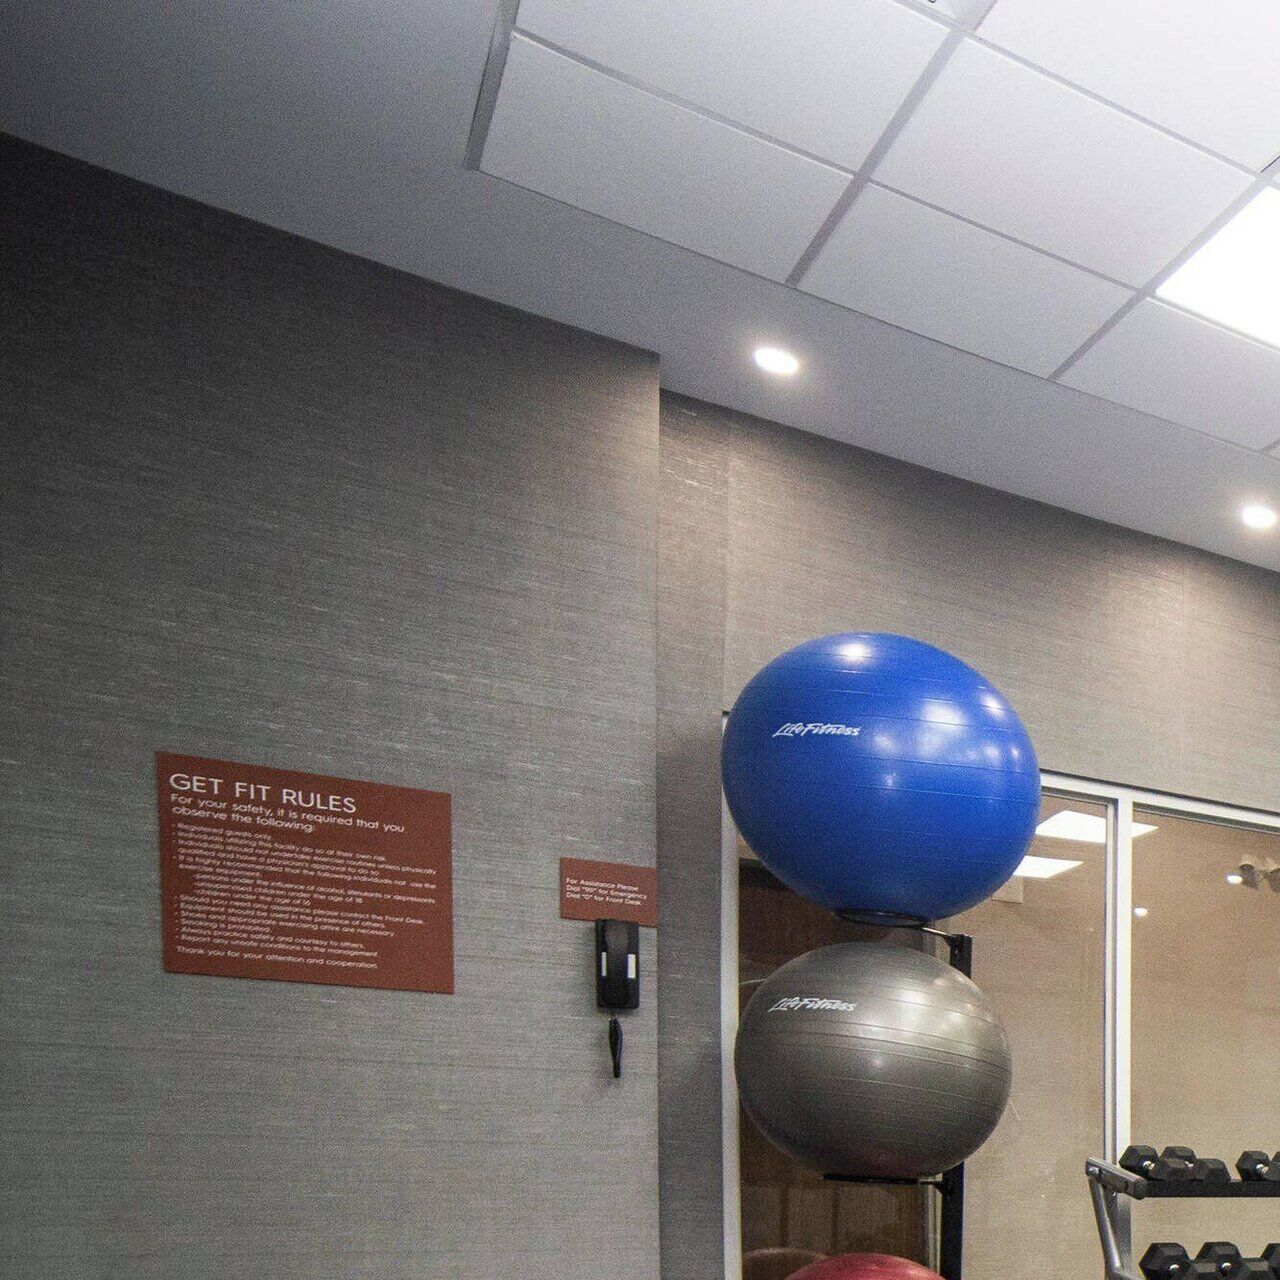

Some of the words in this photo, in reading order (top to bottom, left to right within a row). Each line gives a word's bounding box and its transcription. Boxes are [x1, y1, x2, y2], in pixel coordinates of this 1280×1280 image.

[169, 772, 223, 795] GET
[235, 781, 271, 802] FIT
[282, 788, 356, 813] RULES
[170, 793, 193, 805] For
[198, 797, 227, 810] your
[232, 801, 273, 816] safety,
[277, 807, 284, 818] it
[288, 809, 297, 819] is
[301, 811, 352, 827] required
[356, 818, 378, 830] that
[383, 822, 404, 834] you
[172, 805, 227, 822] observe
[231, 813, 251, 825] the
[256, 816, 315, 834] following:
